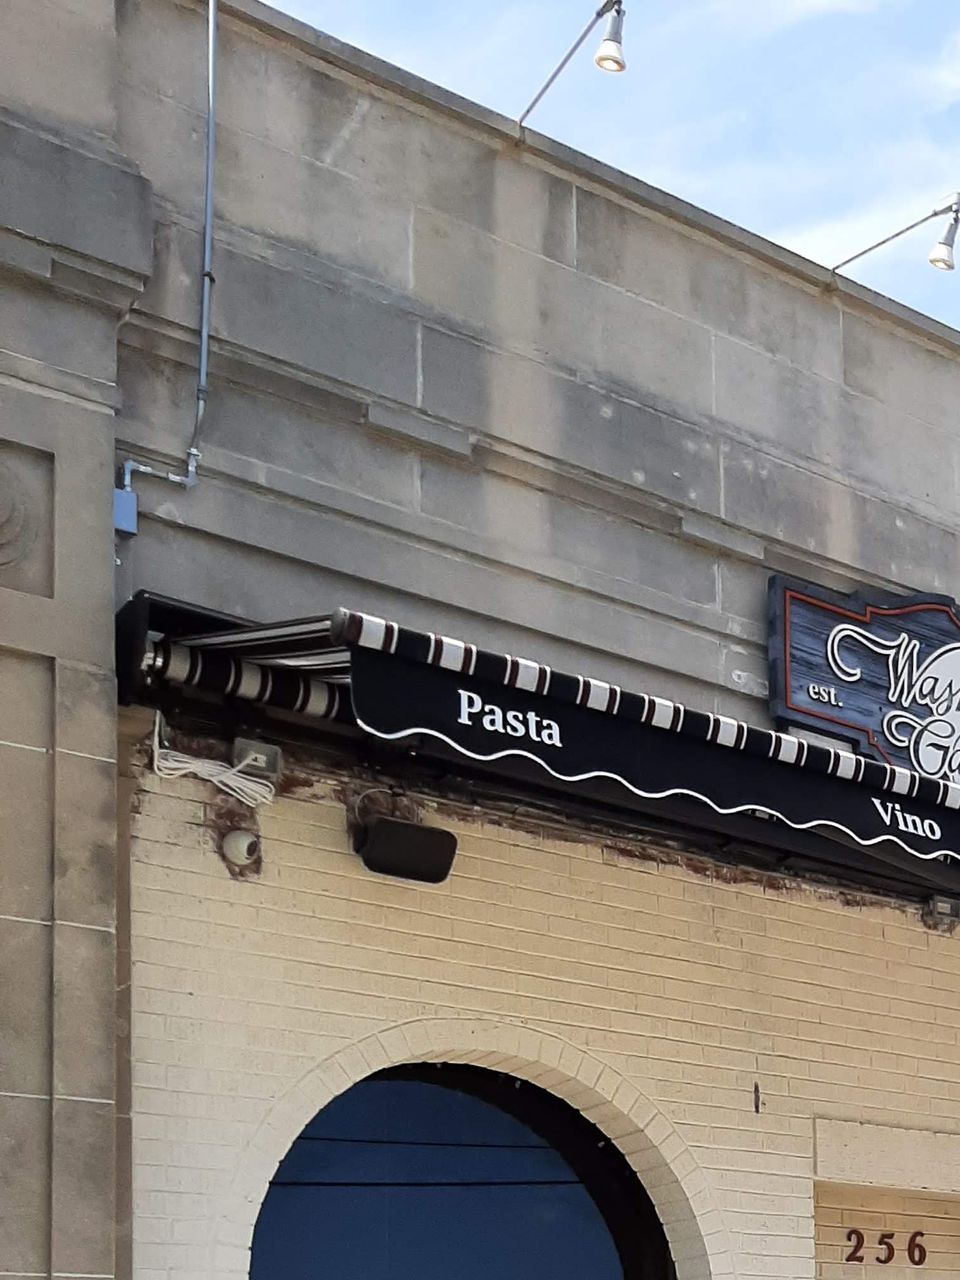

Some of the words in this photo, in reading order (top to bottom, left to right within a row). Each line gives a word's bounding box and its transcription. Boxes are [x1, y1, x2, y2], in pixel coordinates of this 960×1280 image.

[809, 684, 844, 707] est.
[457, 689, 563, 748] Pasta
[871, 797, 942, 840] Vino
[845, 1229, 927, 1266] 256
